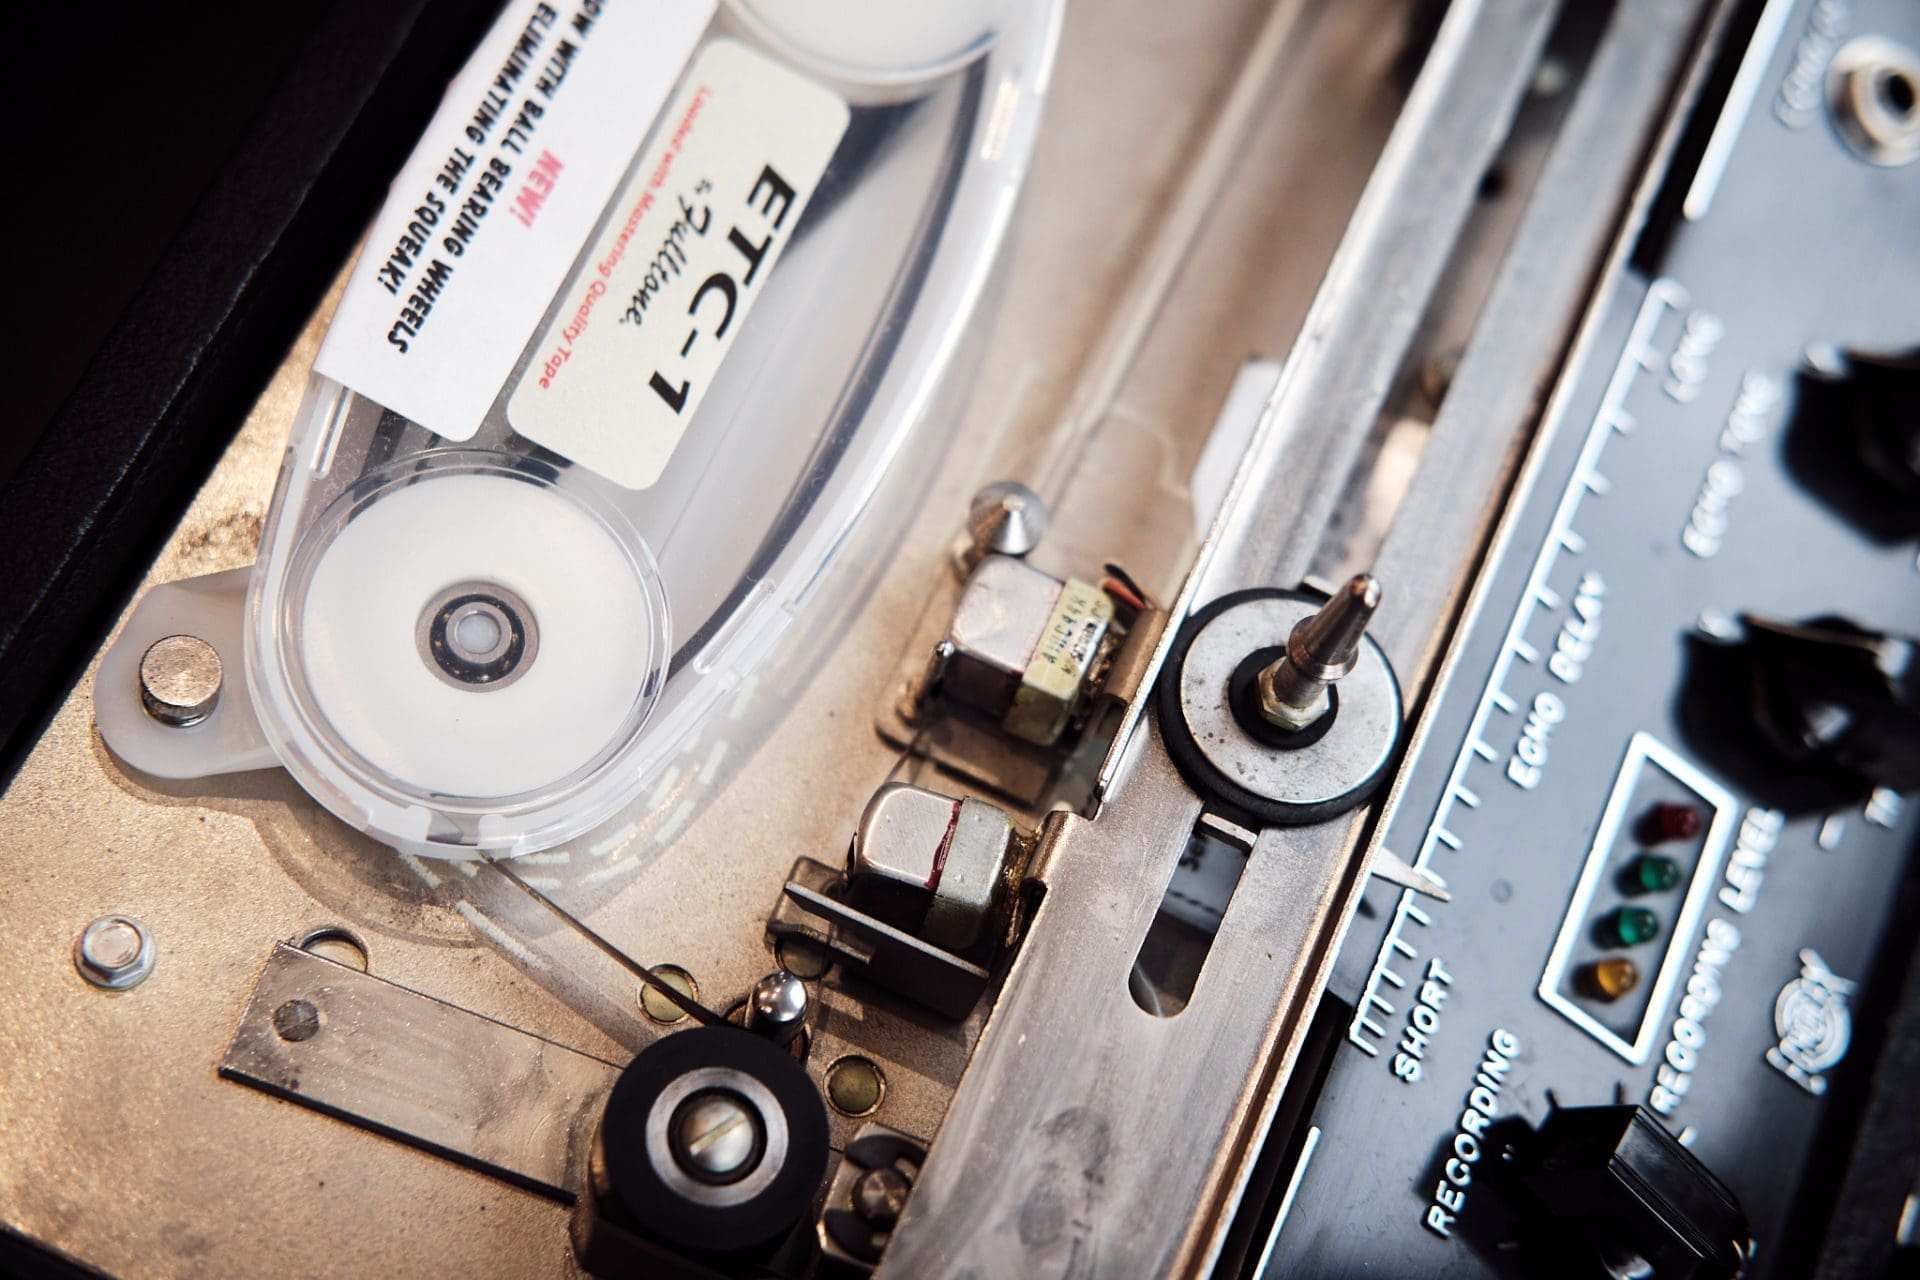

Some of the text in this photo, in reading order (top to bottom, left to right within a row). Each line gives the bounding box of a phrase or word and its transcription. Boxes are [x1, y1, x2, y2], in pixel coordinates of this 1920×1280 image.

[534, 39, 579, 99] WITH
[377, 3, 558, 295] ELIMINATING THE SQUEAK!
[501, 98, 545, 156] BALL
[650, 153, 676, 189] with
[443, 157, 512, 257] BEARING
[509, 151, 563, 229] NEW!
[599, 191, 656, 280] Mastering
[387, 259, 454, 354] WHEELS
[562, 280, 609, 346] Quality
[648, 164, 796, 415] ETC-1
[538, 347, 573, 390] Tape
[1508, 570, 1606, 790] ECHO DELAY
[1650, 807, 1785, 1115] RECORDING LEVEL
[1394, 957, 1455, 1083] SHORT
[1425, 1028, 1522, 1238] RECORDING
